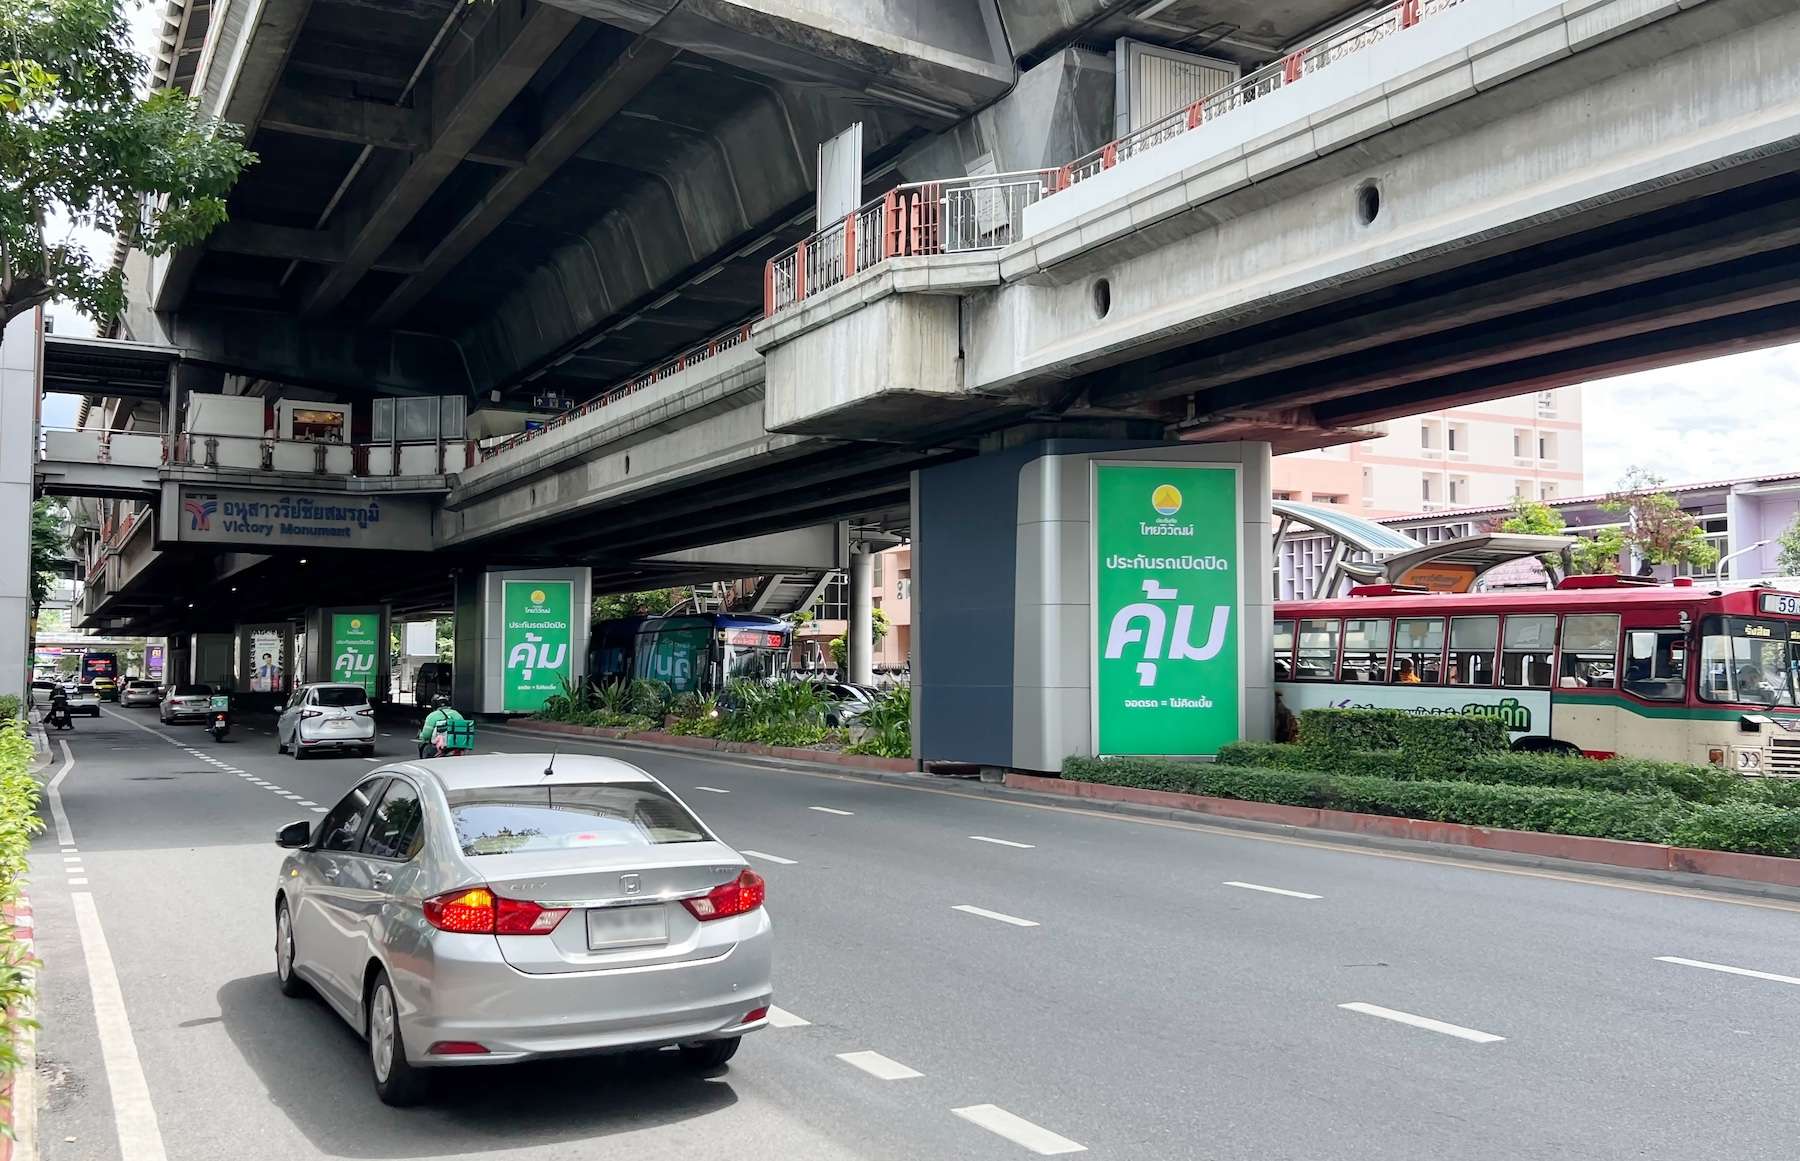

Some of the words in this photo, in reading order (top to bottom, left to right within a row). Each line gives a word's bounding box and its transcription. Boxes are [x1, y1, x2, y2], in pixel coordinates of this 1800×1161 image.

[223, 496, 381, 528] อนุสาวรีย์ชัยสมรภูมิ
[223, 519, 273, 536] Victory
[280, 523, 351, 538] Monument
[1139, 521, 1194, 536] ไทยวิวัฒน์
[1106, 554, 1228, 572] ประกันรถเปิดปิด
[1778, 597, 1796, 613] 59
[1104, 579, 1231, 687] คุ้ม
[335, 646, 374, 679] คุ้ม
[508, 632, 567, 681] คุ้ม
